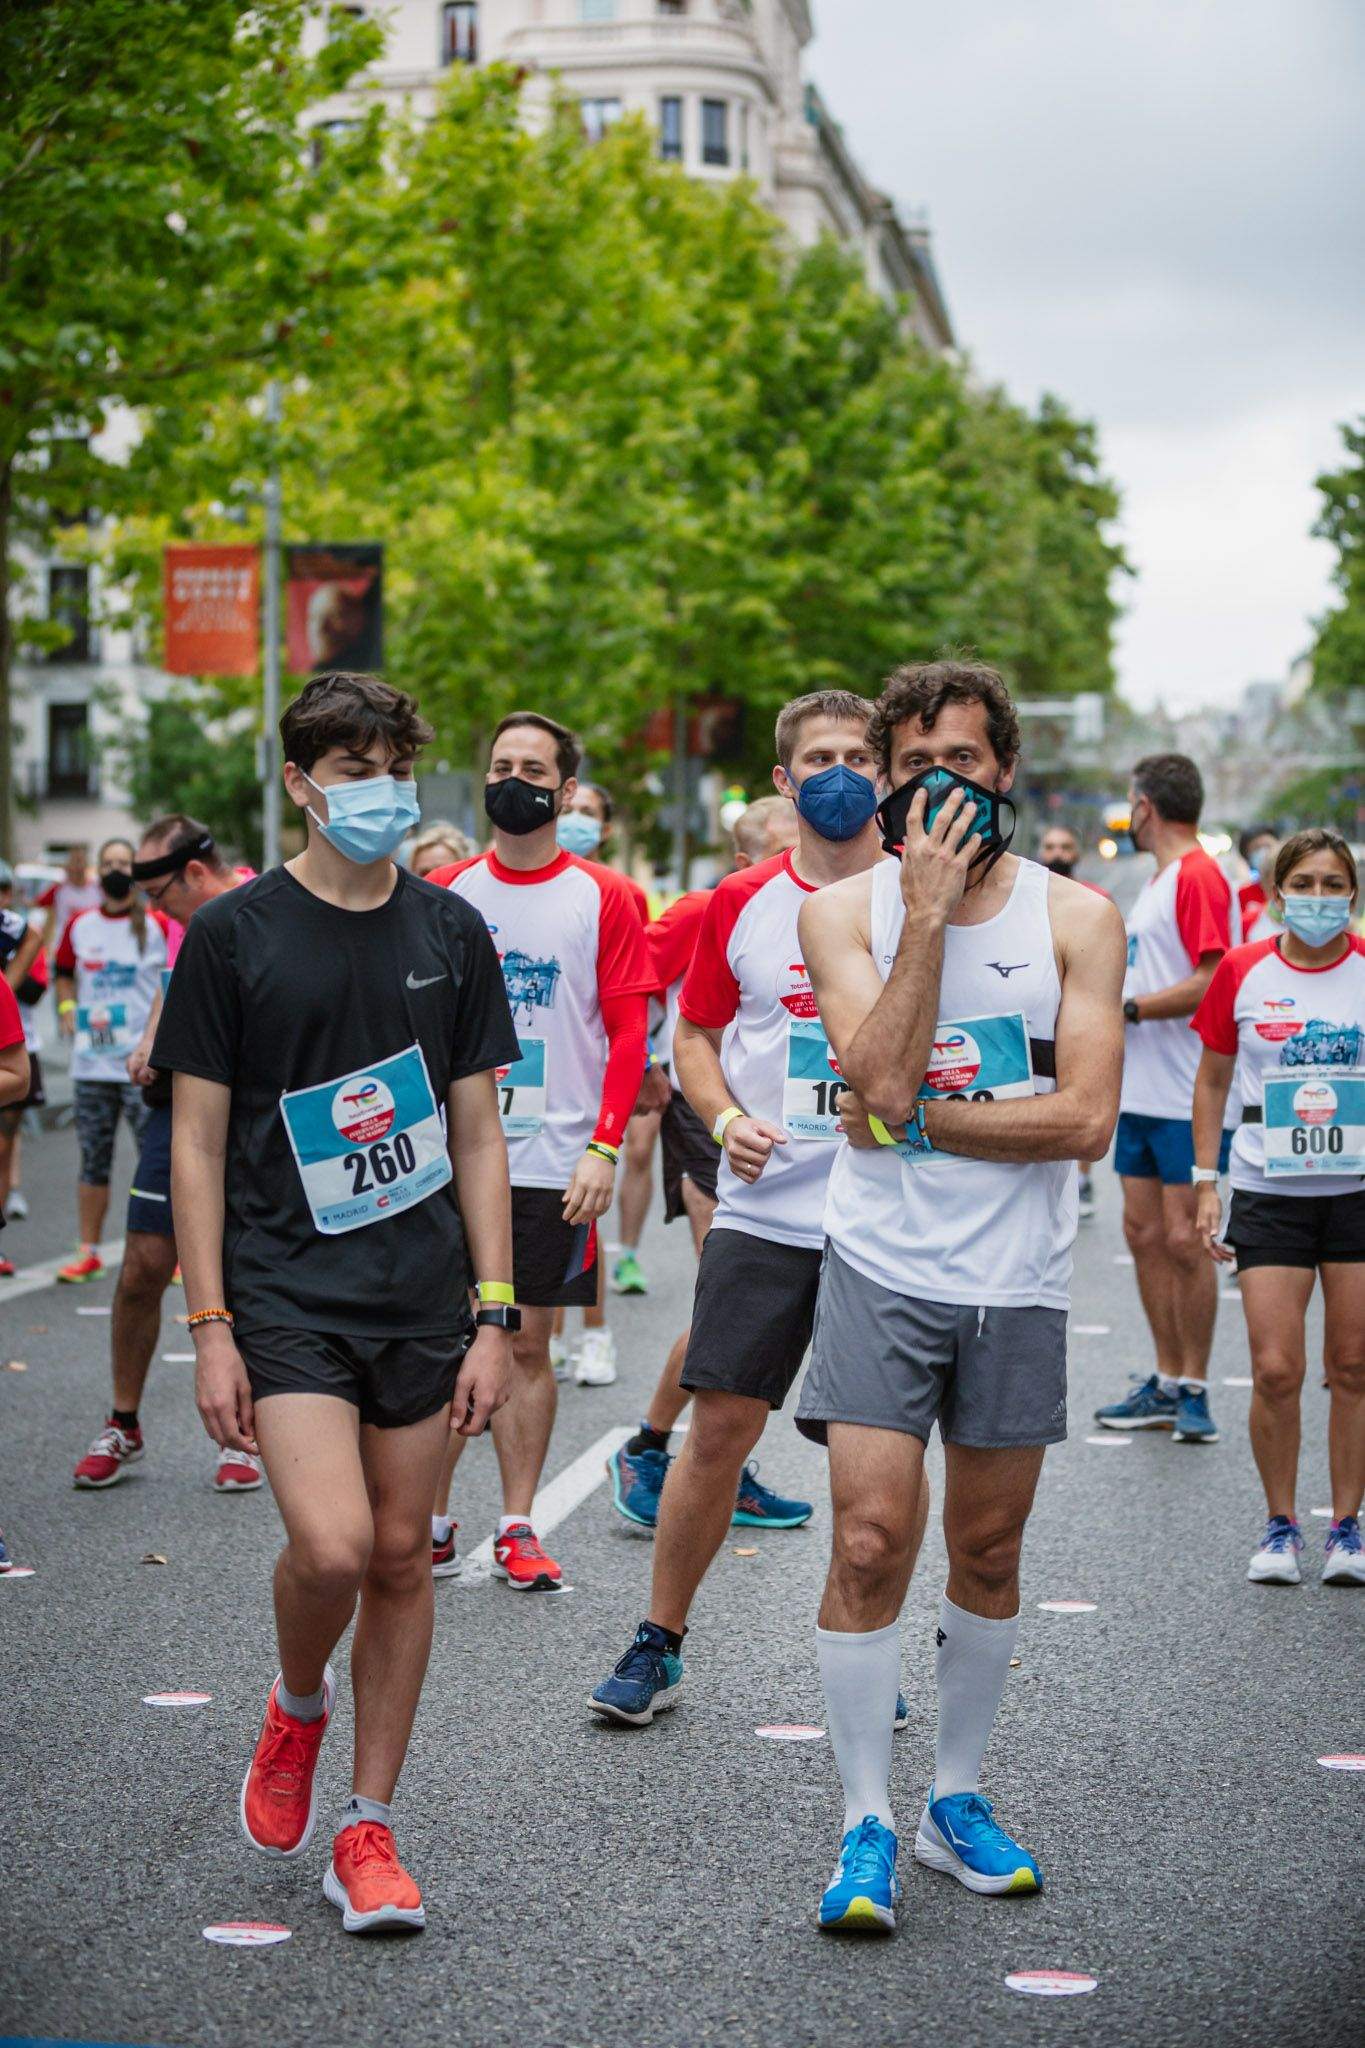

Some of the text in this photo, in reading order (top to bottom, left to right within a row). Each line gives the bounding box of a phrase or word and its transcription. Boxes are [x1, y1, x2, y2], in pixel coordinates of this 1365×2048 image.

[497, 1087, 514, 1116] 7
[797, 1123, 828, 1132] MADRID
[1291, 1126, 1344, 1155] 600
[343, 1132, 416, 1197] 260
[333, 1204, 369, 1221] MADRID
